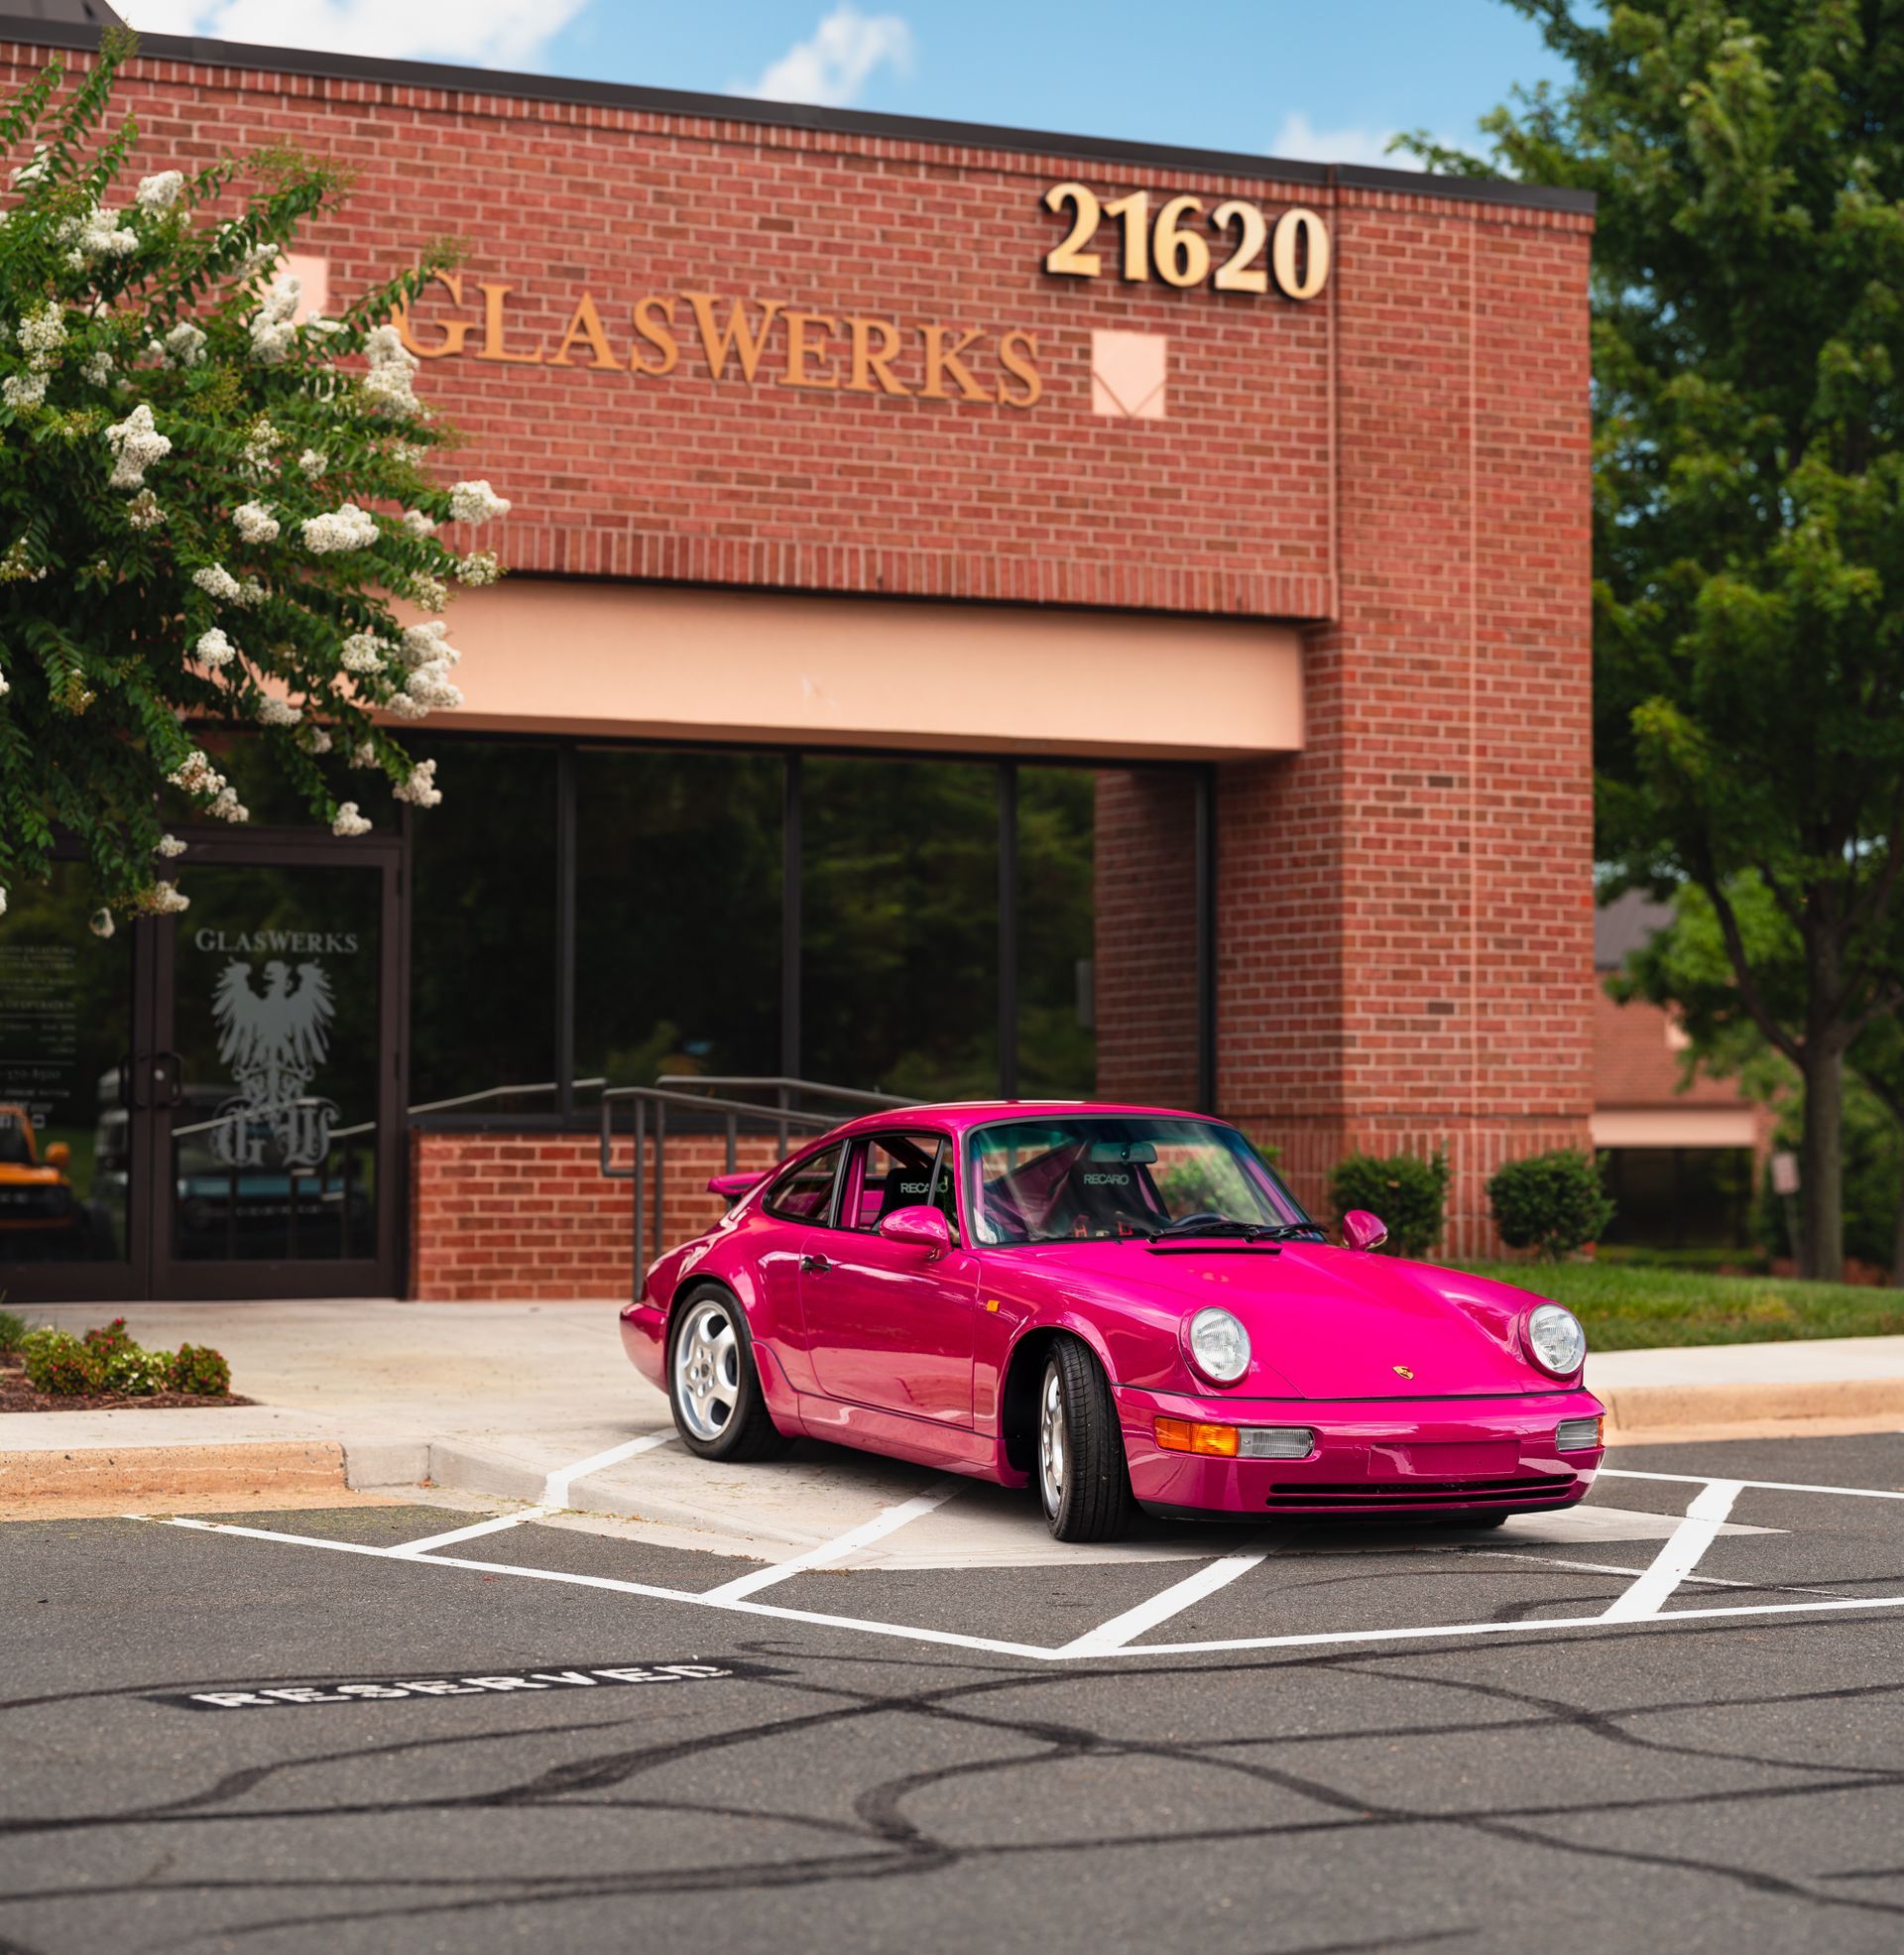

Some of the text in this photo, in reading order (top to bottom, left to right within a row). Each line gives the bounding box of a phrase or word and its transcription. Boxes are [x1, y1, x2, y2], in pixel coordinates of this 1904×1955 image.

[1043, 183, 1330, 300] 21620
[391, 267, 1042, 408] GLASWERKS
[194, 927, 359, 953] GLASWERKS
[900, 1182, 948, 1193] RECAO
[1083, 1173, 1130, 1185] RECARO
[190, 1664, 734, 1708] RESERVED
